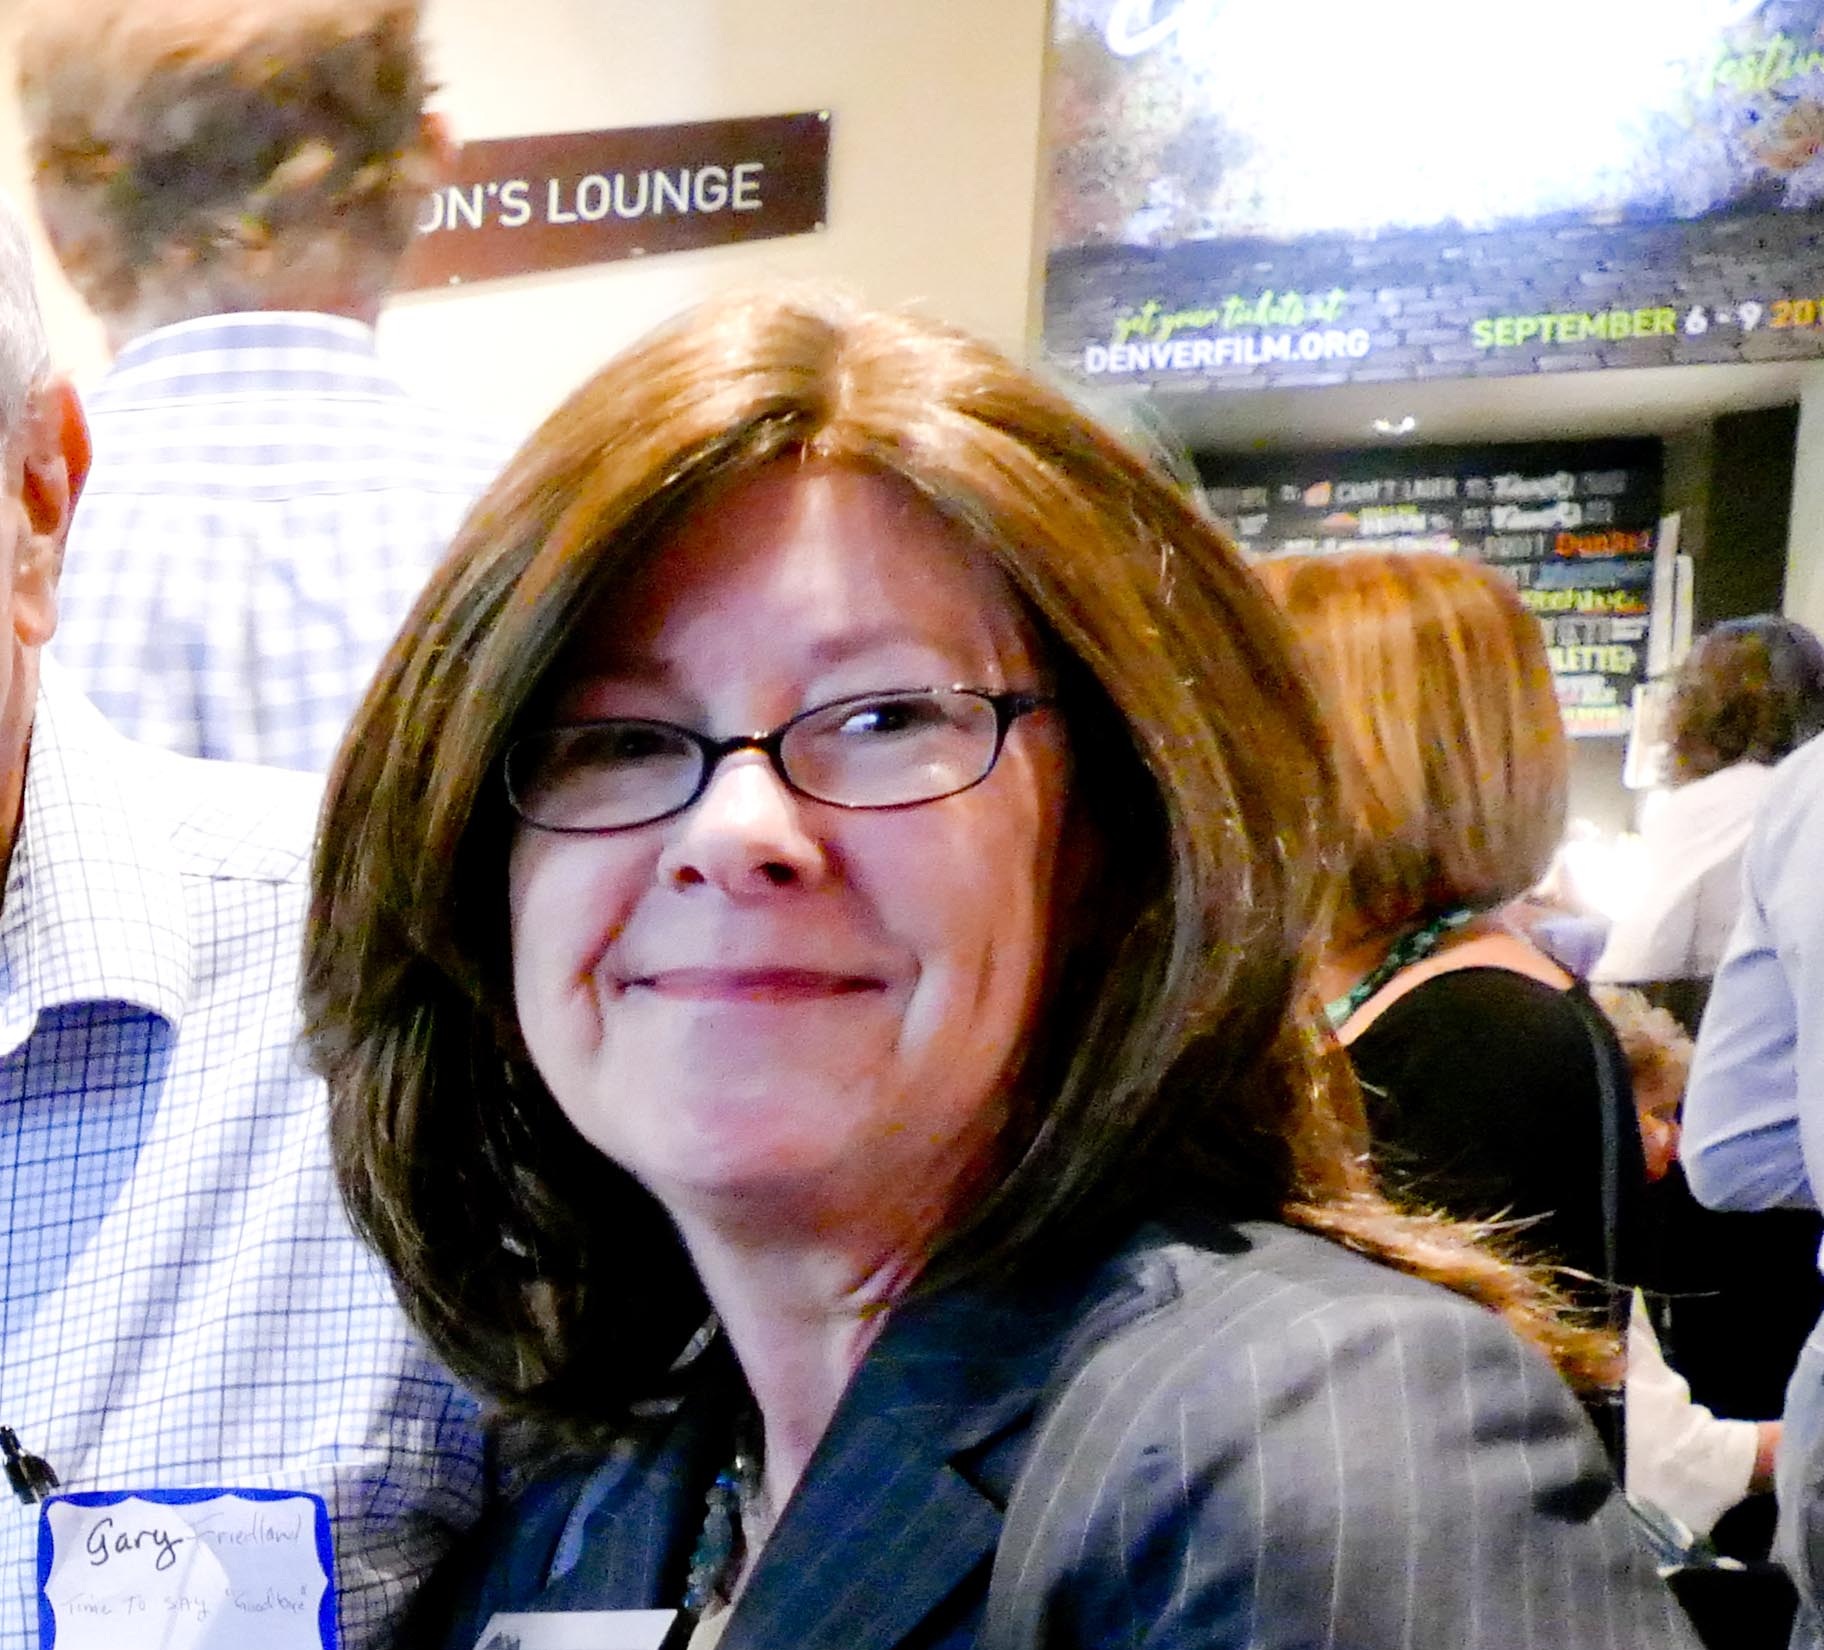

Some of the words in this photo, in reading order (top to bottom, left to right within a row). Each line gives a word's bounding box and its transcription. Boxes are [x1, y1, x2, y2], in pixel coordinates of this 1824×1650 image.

[548, 163, 765, 225] LOUNGE
[1472, 306, 1677, 348] SEPTEMBER
[1684, 304, 1708, 335] 6
[1738, 300, 1763, 331] 9
[1085, 328, 1371, 374] DENVERFILM.ORG
[86, 1517, 184, 1571] Gary
